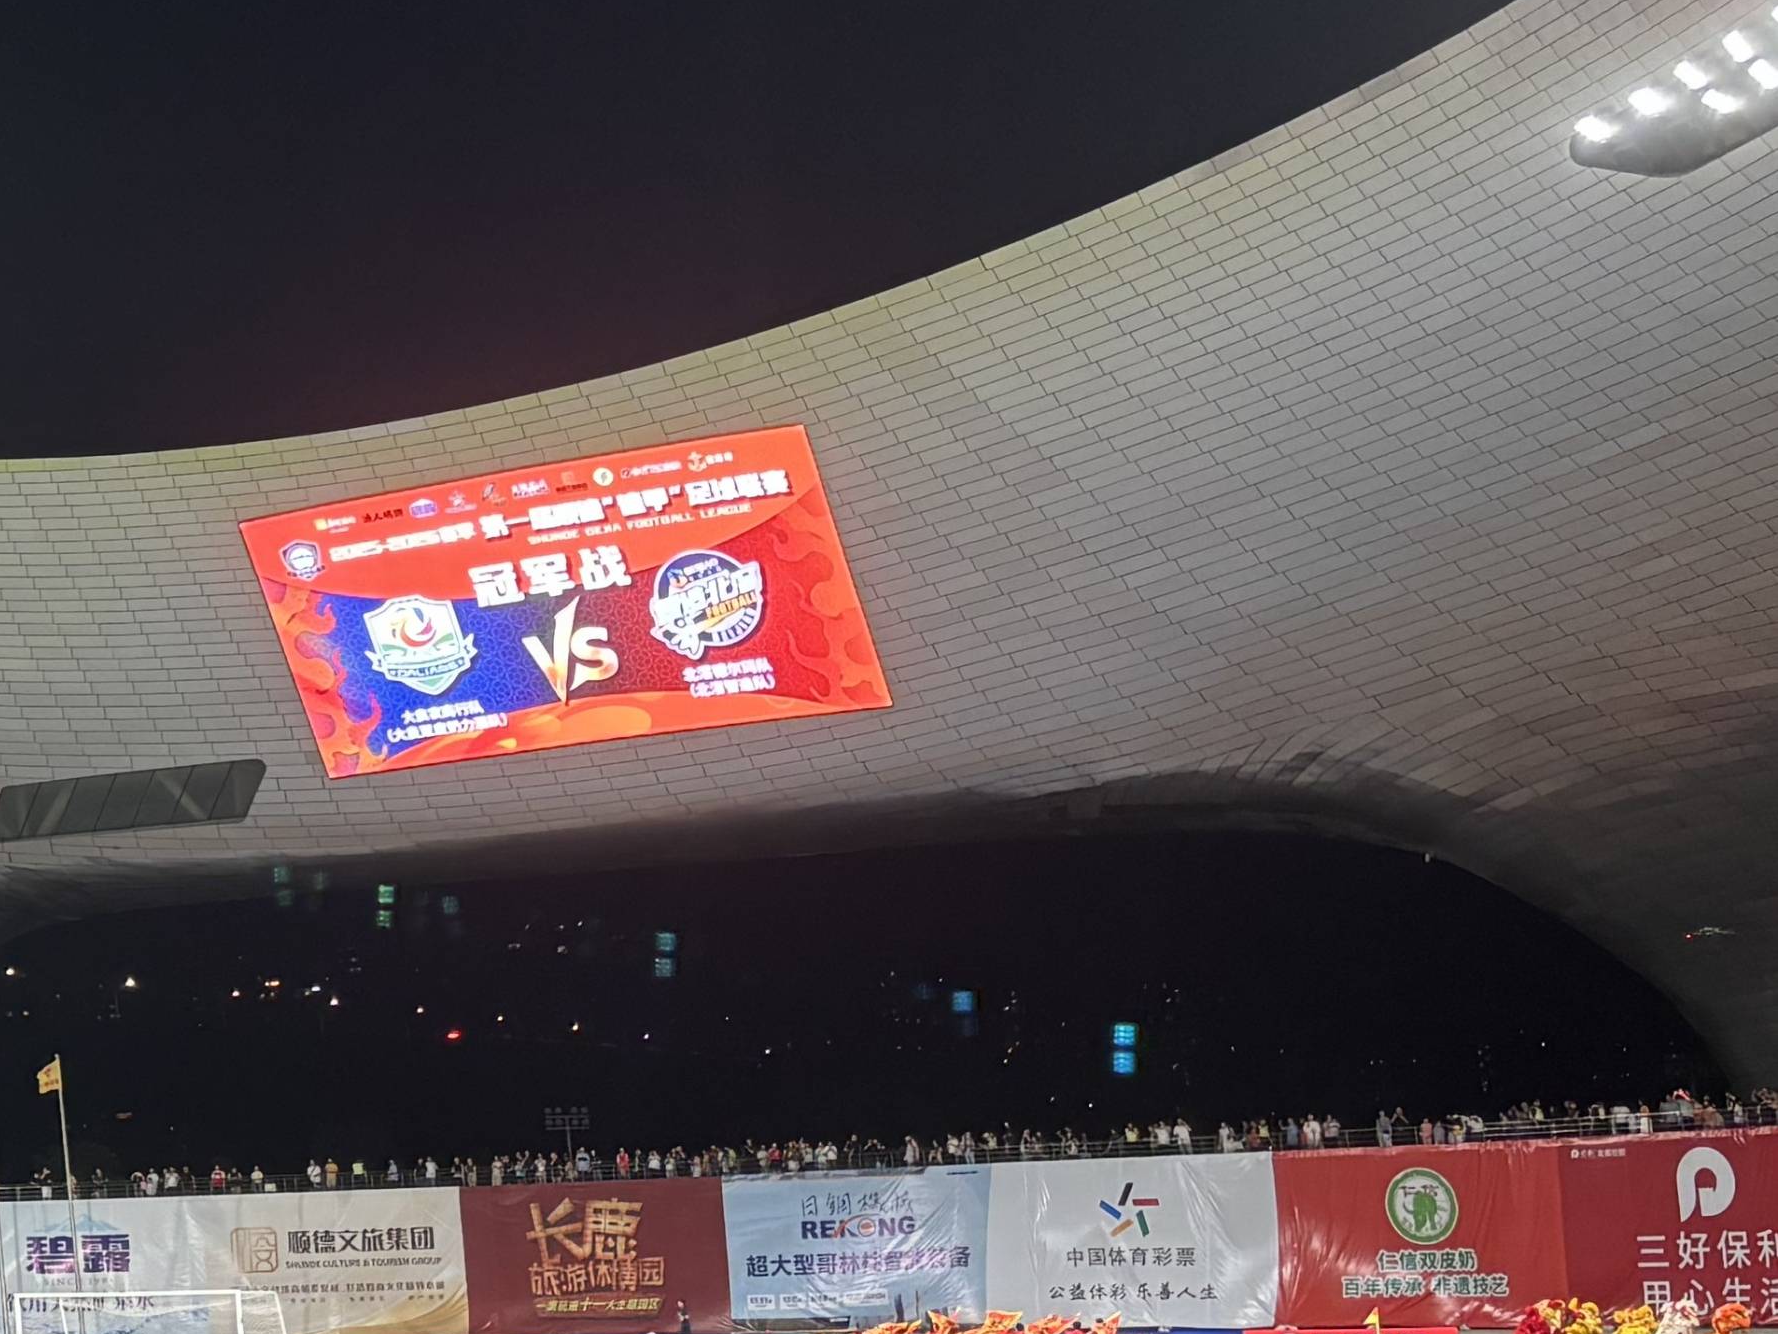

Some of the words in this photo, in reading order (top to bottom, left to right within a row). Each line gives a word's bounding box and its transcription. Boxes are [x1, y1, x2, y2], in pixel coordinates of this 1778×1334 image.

[468, 545, 632, 608] 冠军战
[521, 597, 618, 705] VS
[288, 1226, 435, 1254] 顺德文旅集团
[526, 1197, 643, 1266] 长鹿
[802, 1215, 915, 1240] REKONG
[1066, 1247, 1196, 1267] 中国体育彩票
[1377, 1249, 1476, 1271] 仁信双皮奶
[1637, 1229, 1778, 1269] 三好保利
[528, 1256, 664, 1295] 旅游休博园
[1342, 1277, 1425, 1298] 百年传承
[1432, 1274, 1510, 1297] 非遗技艺
[1048, 1282, 1127, 1300] 公益体彩
[1136, 1281, 1218, 1300] 乐善人生
